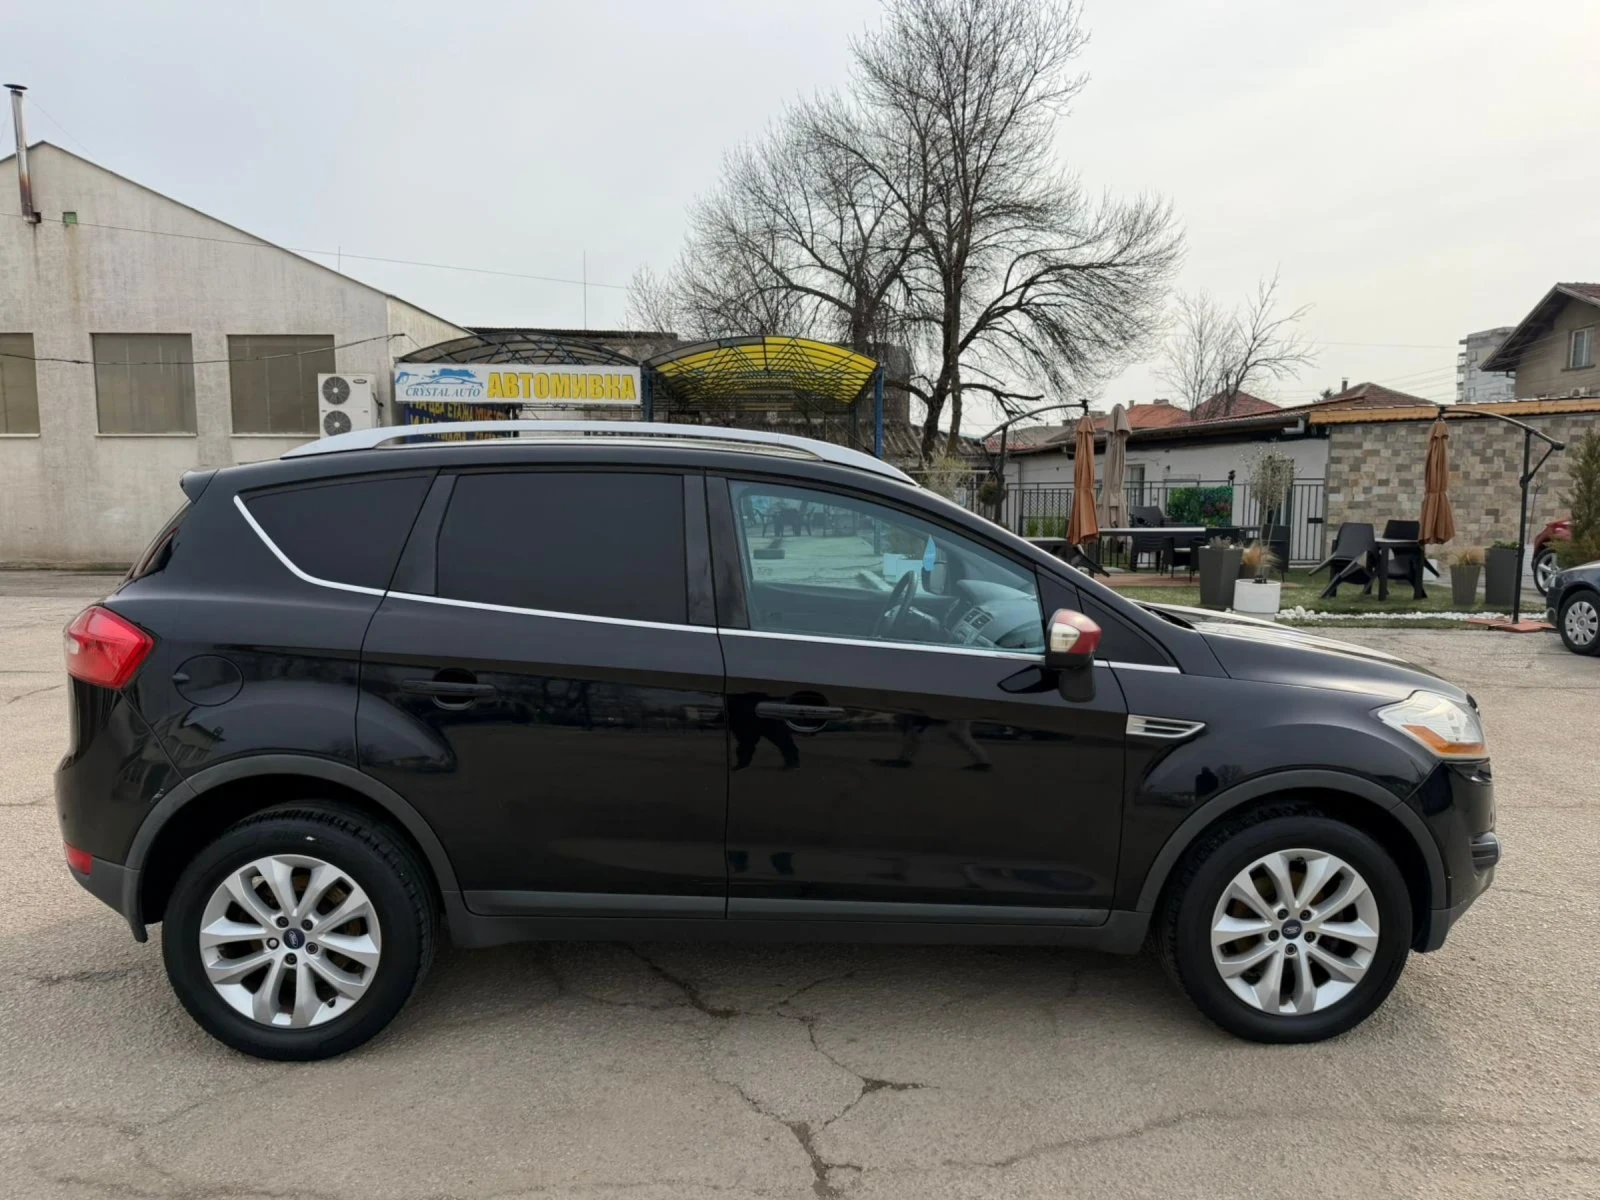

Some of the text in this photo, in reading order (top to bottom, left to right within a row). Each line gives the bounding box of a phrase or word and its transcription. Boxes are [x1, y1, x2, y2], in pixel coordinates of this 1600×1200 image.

[405, 386, 480, 397] CRYSTAL AUTO
[487, 372, 636, 399] АВТОМИВКА
